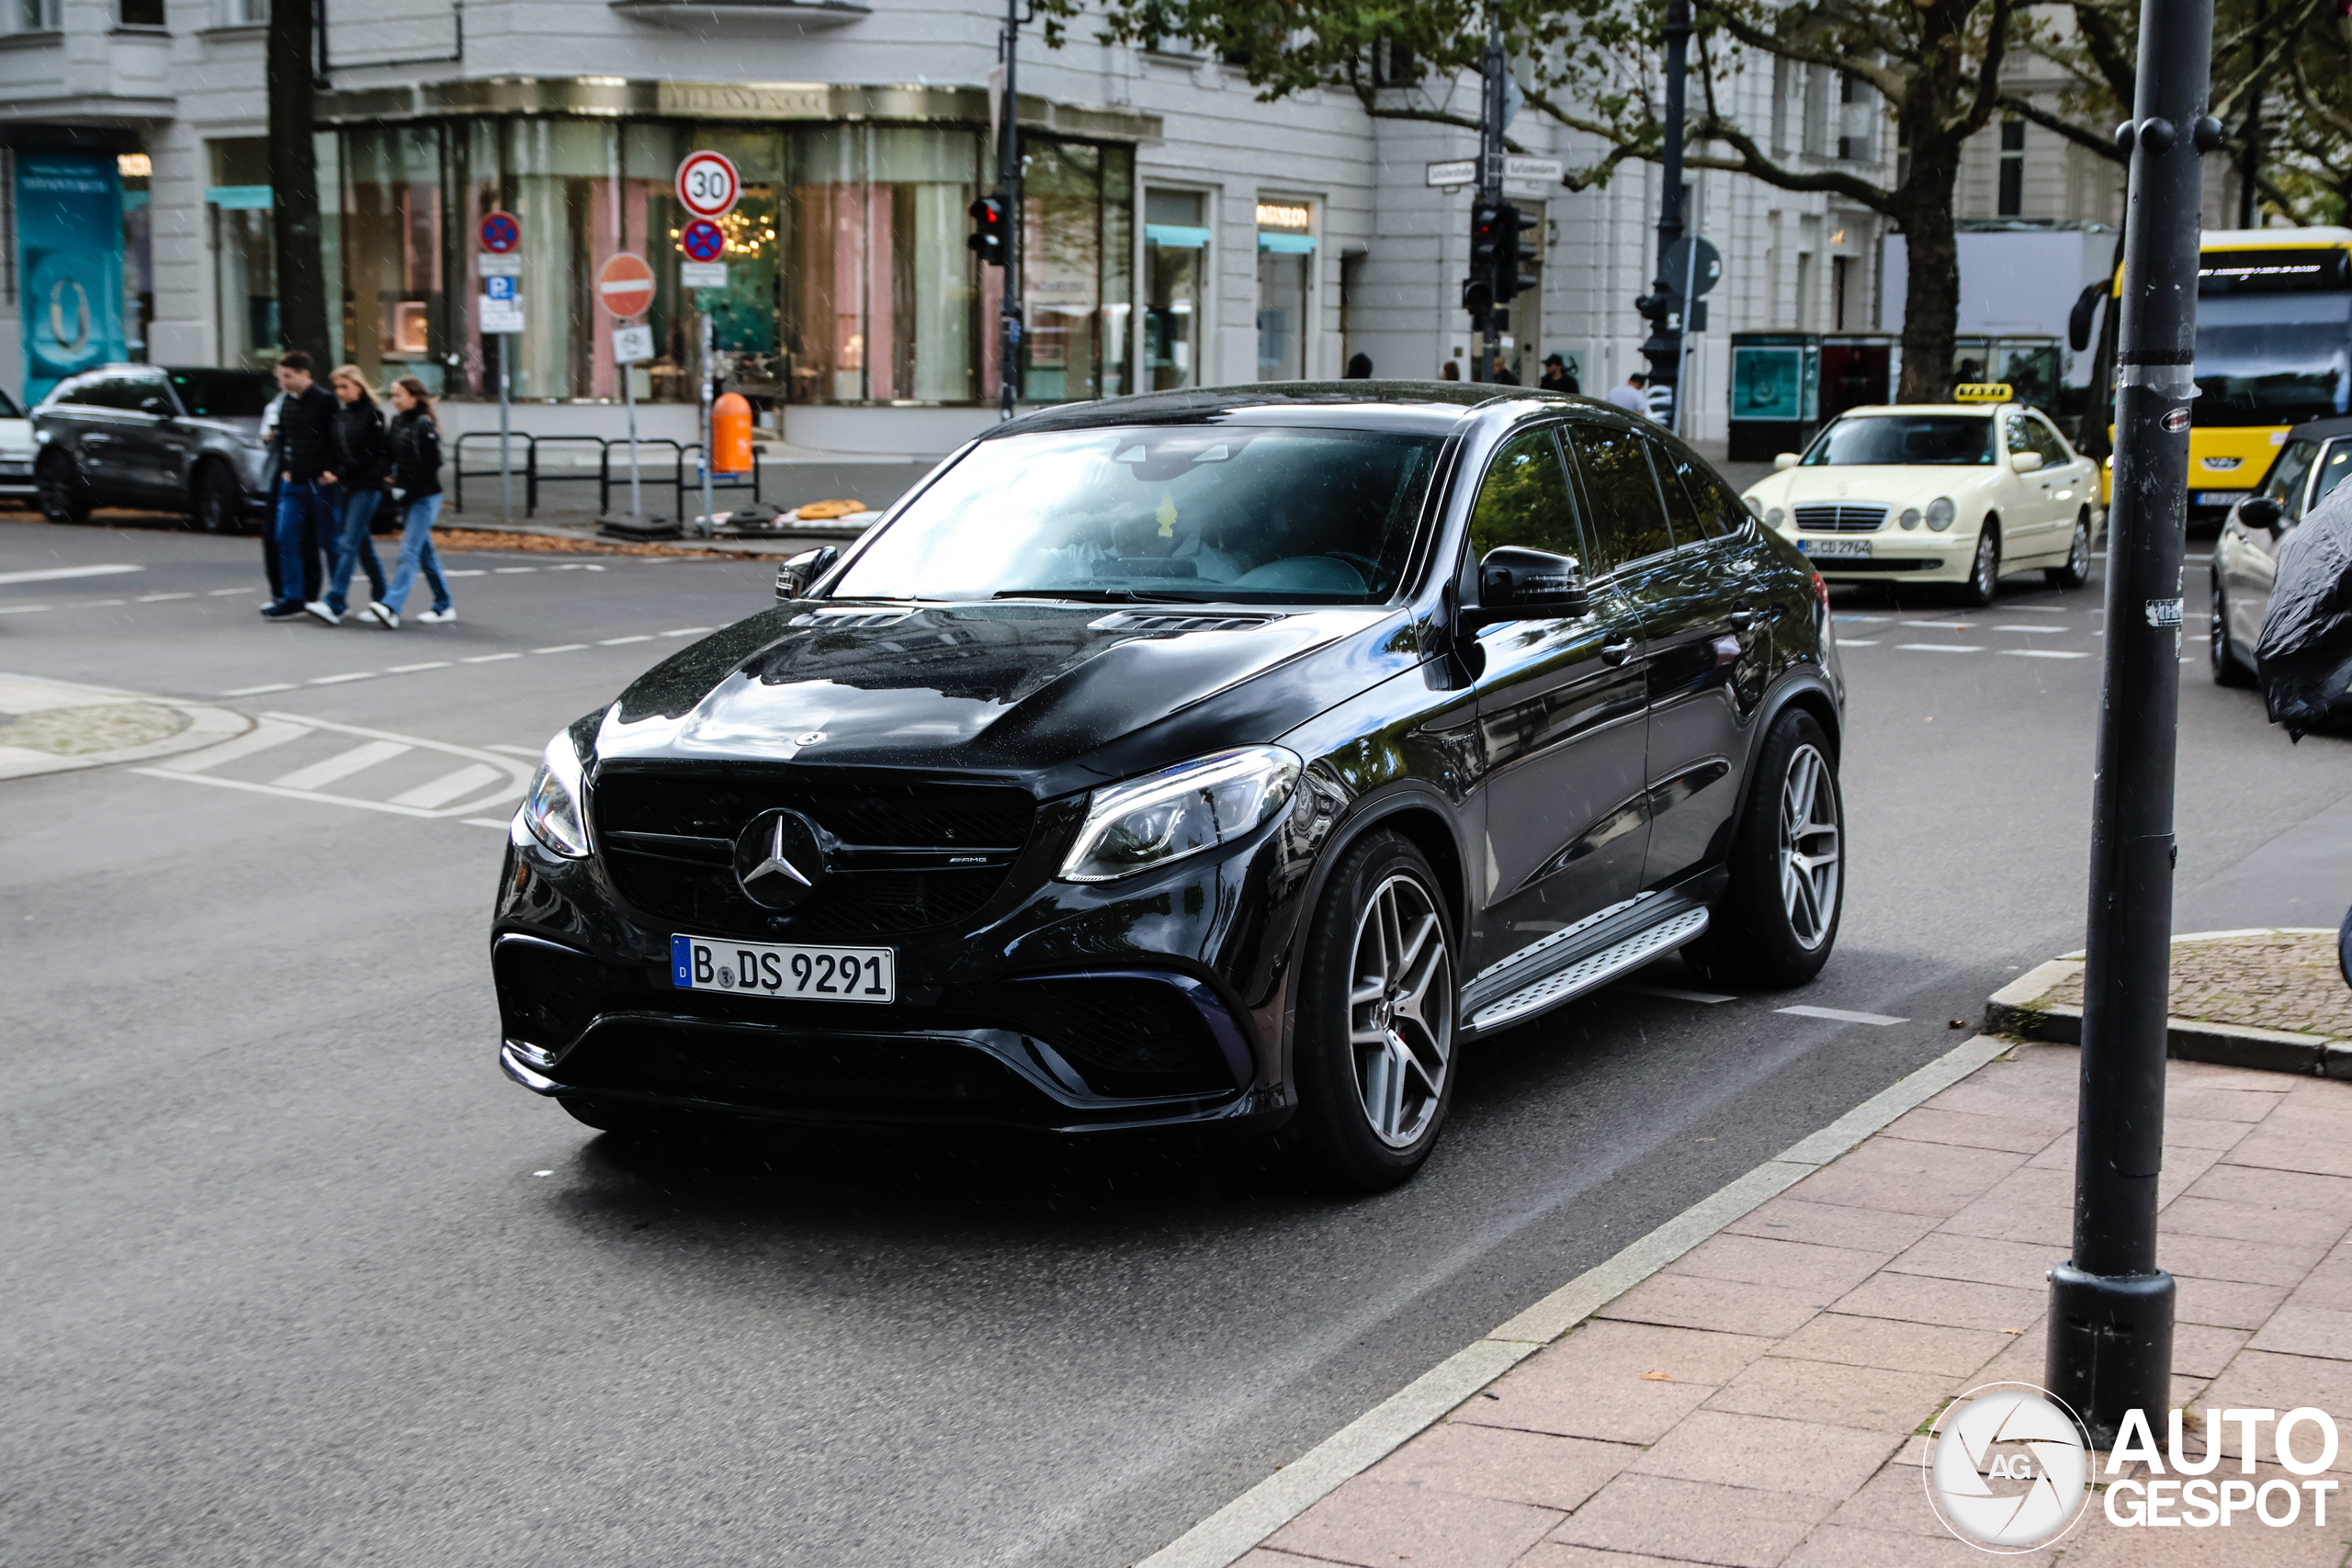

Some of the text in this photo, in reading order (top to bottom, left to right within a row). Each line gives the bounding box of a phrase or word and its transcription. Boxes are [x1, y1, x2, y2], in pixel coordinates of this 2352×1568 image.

[692, 171, 725, 198] 30
[490, 277, 509, 297] P
[679, 966, 687, 978] D
[694, 944, 887, 995] B DS 9291
